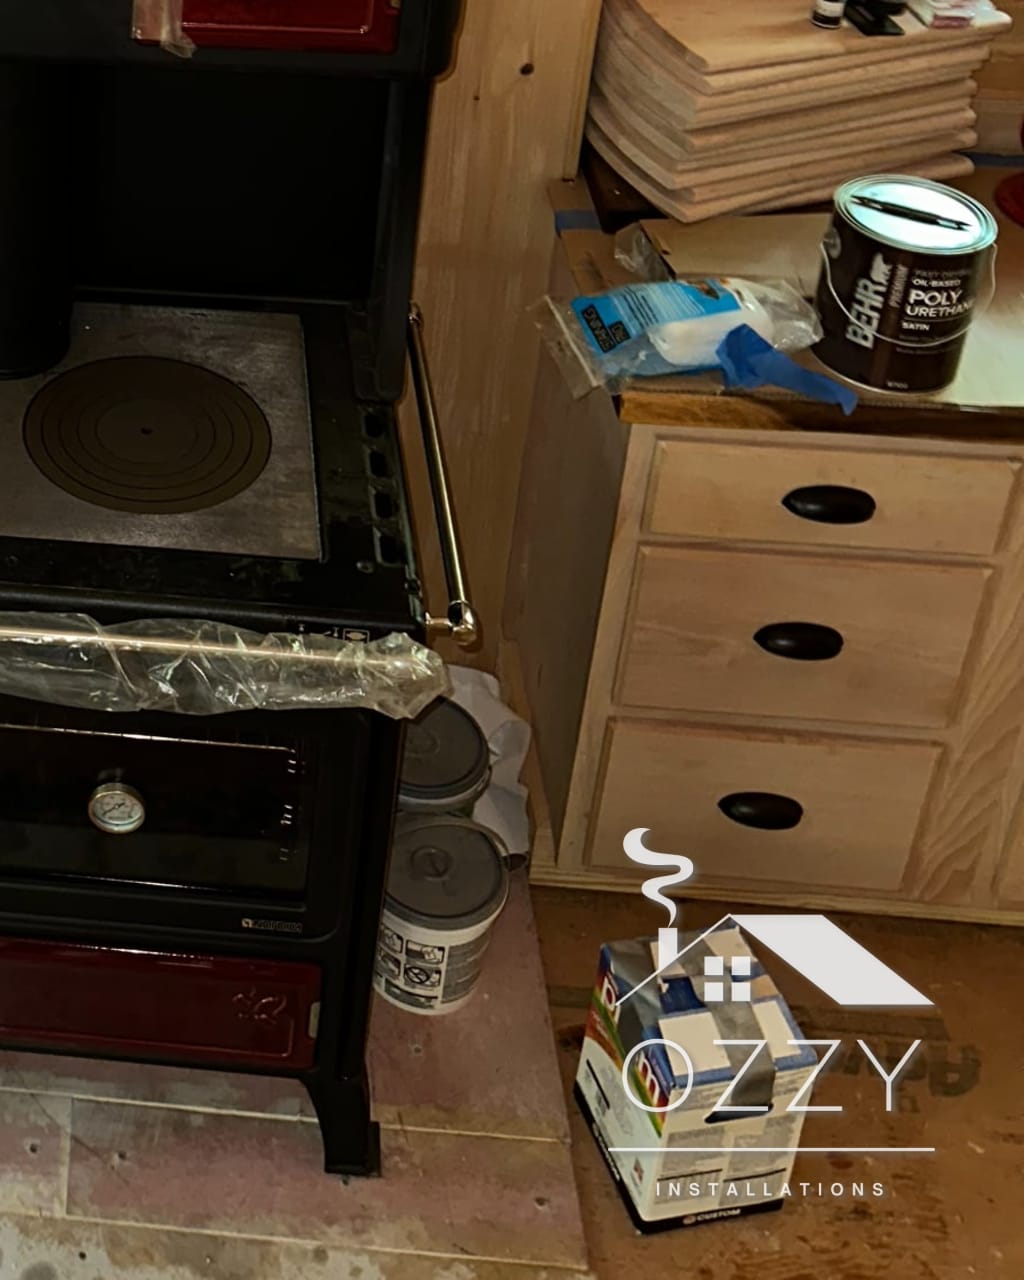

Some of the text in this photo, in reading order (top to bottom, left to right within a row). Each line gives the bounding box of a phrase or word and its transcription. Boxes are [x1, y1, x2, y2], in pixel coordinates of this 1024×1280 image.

[908, 289, 963, 306] POLY
[846, 278, 887, 349] BEHR
[901, 322, 930, 331] SATIN
